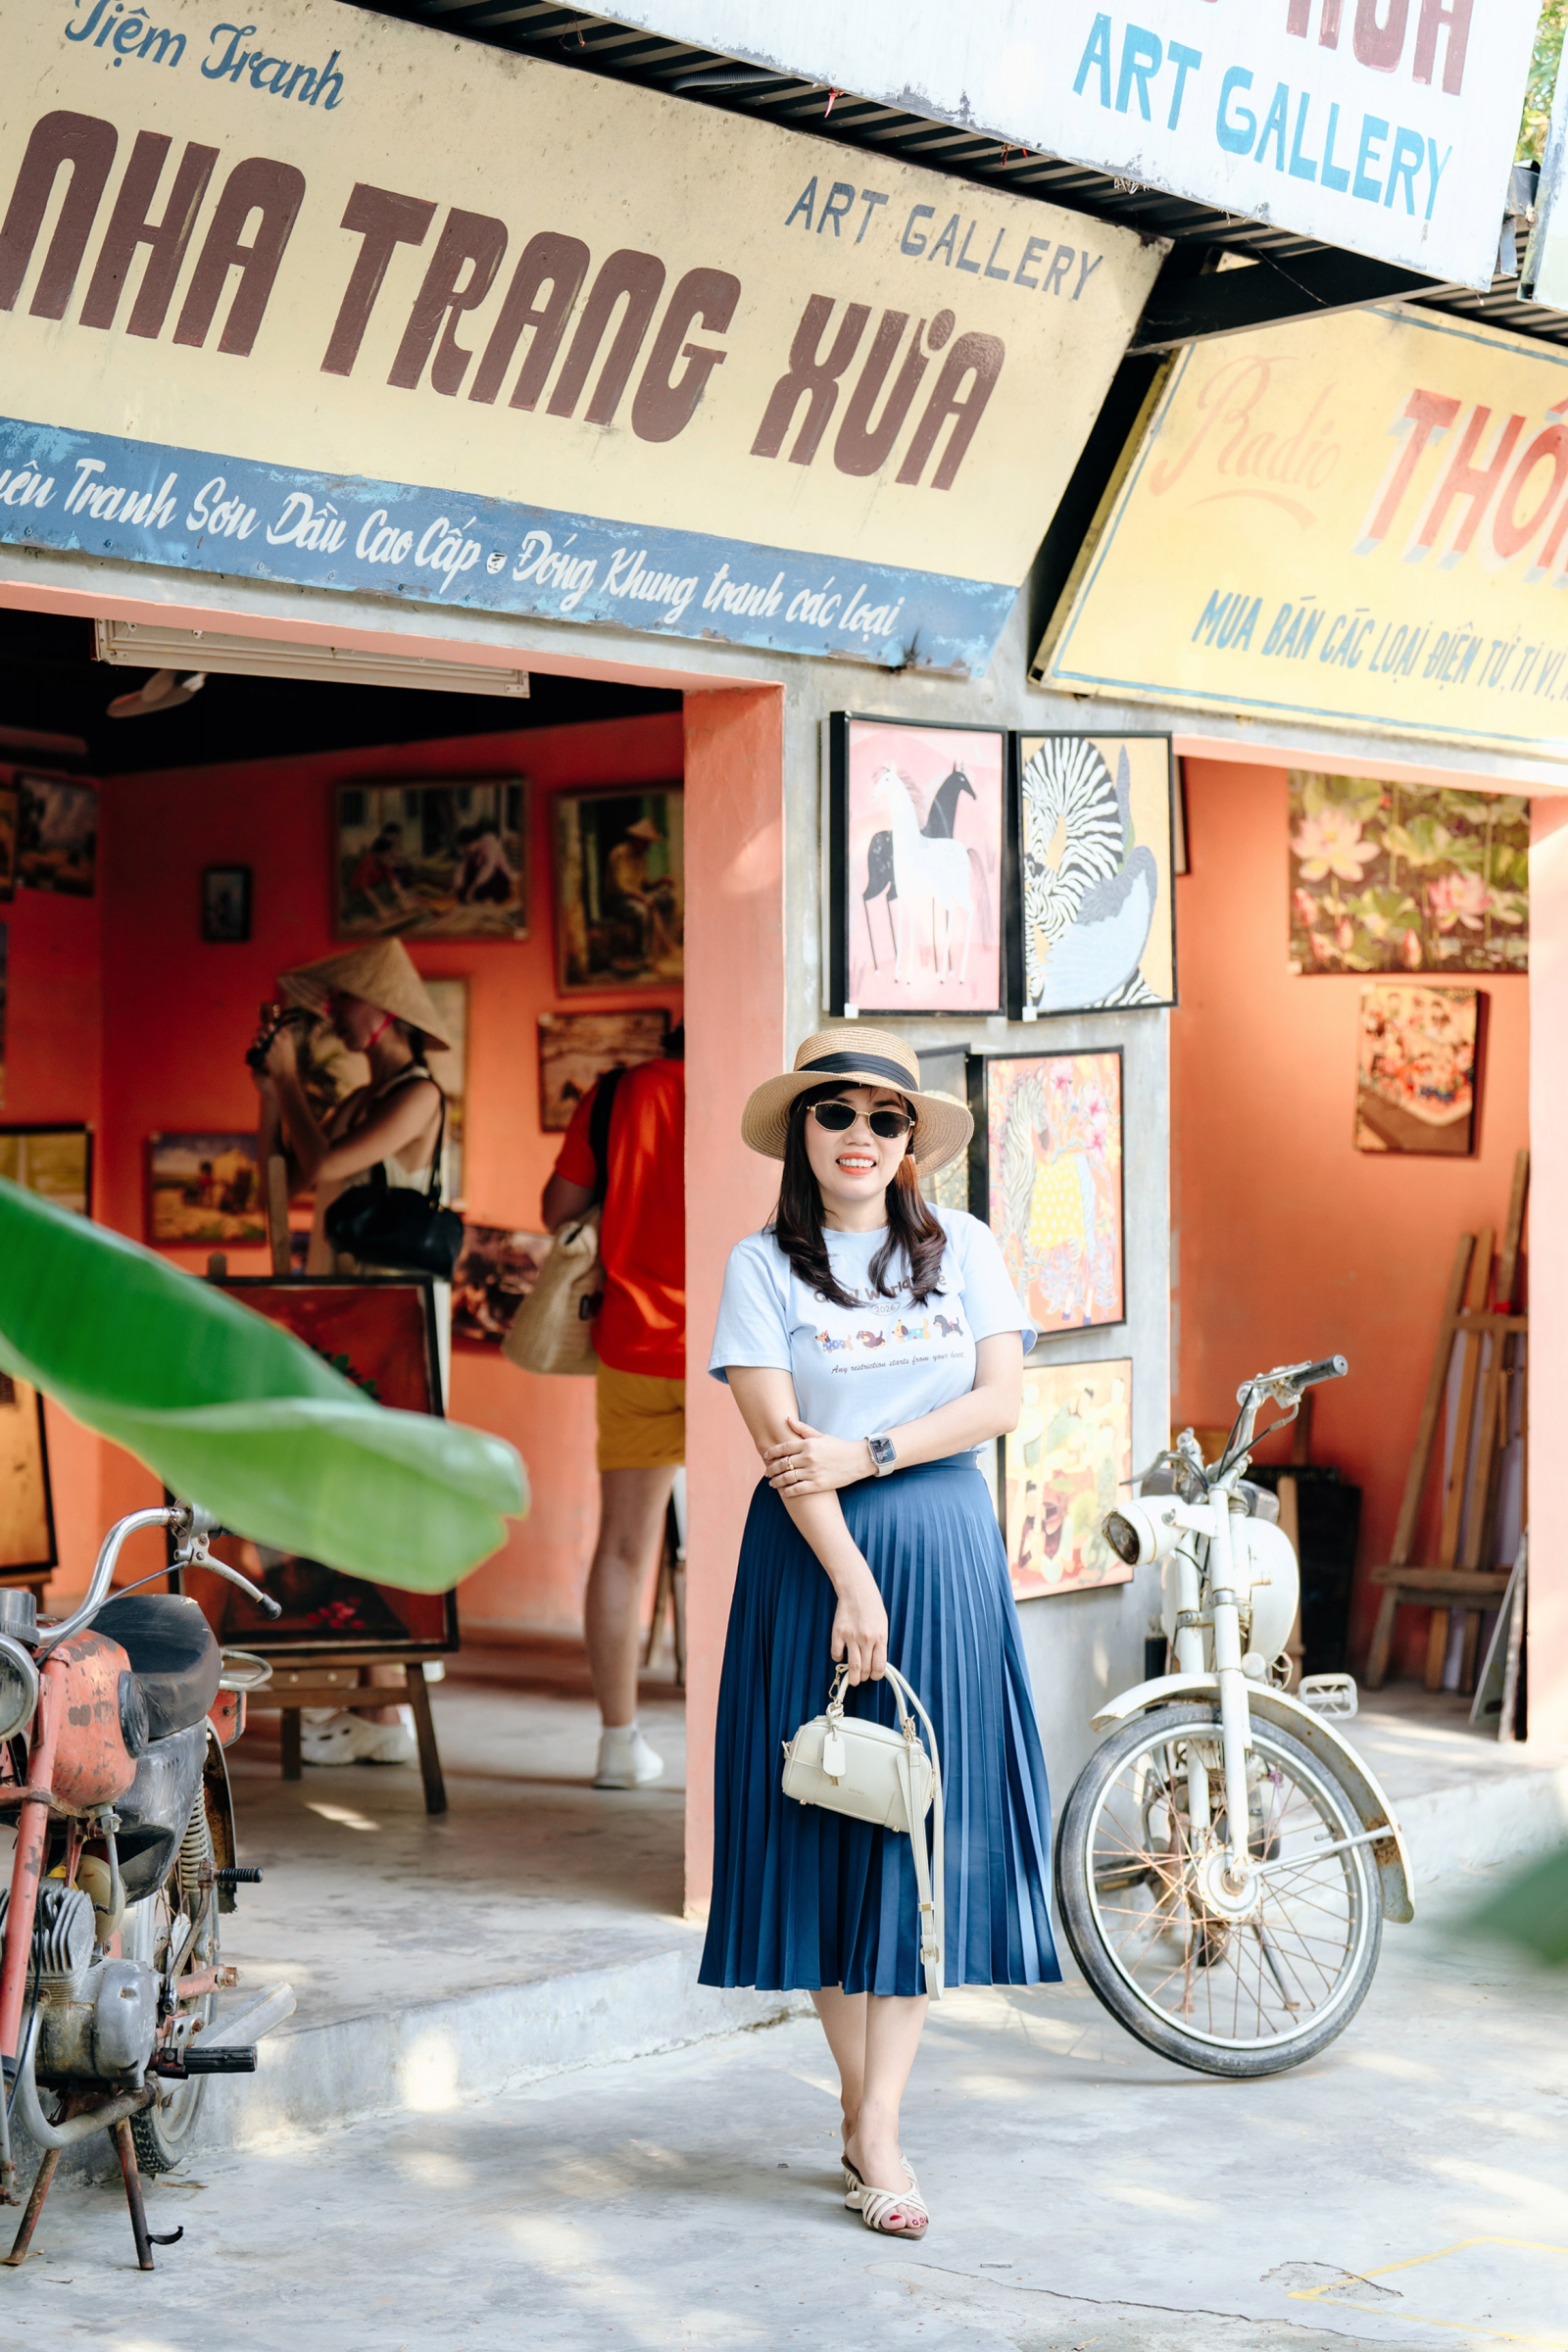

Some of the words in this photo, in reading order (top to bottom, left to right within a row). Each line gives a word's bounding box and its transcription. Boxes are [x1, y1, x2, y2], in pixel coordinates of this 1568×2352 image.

[201, 23, 345, 110] Tranh
[1072, 12, 1203, 131] ART
[1216, 66, 1453, 221] GALLERY
[0, 110, 307, 358] NHA
[319, 182, 742, 443] TRANG
[750, 293, 1006, 491] XƯA
[784, 175, 889, 243] ART
[901, 204, 1104, 301] GALLERY
[1149, 354, 1342, 497] Radio
[64, 458, 178, 529] Tranh
[186, 476, 263, 541] Sơn
[267, 491, 350, 554] Dầu
[355, 509, 416, 565] Cao
[414, 515, 482, 595] Cấp
[512, 529, 597, 612] Đóng
[599, 547, 701, 625] Khung
[702, 563, 788, 619] tranh
[785, 576, 844, 627] các
[839, 583, 906, 643] loại
[1191, 589, 1263, 652] MUA
[1368, 620, 1433, 684] LOẠI
[831, 1364, 848, 1374] Any
[850, 1361, 887, 1372] restriction
[888, 1358, 909, 1367] starts
[911, 1355, 929, 1366] from
[932, 1353, 948, 1362] your
[875, 1304, 896, 1313] 2026
